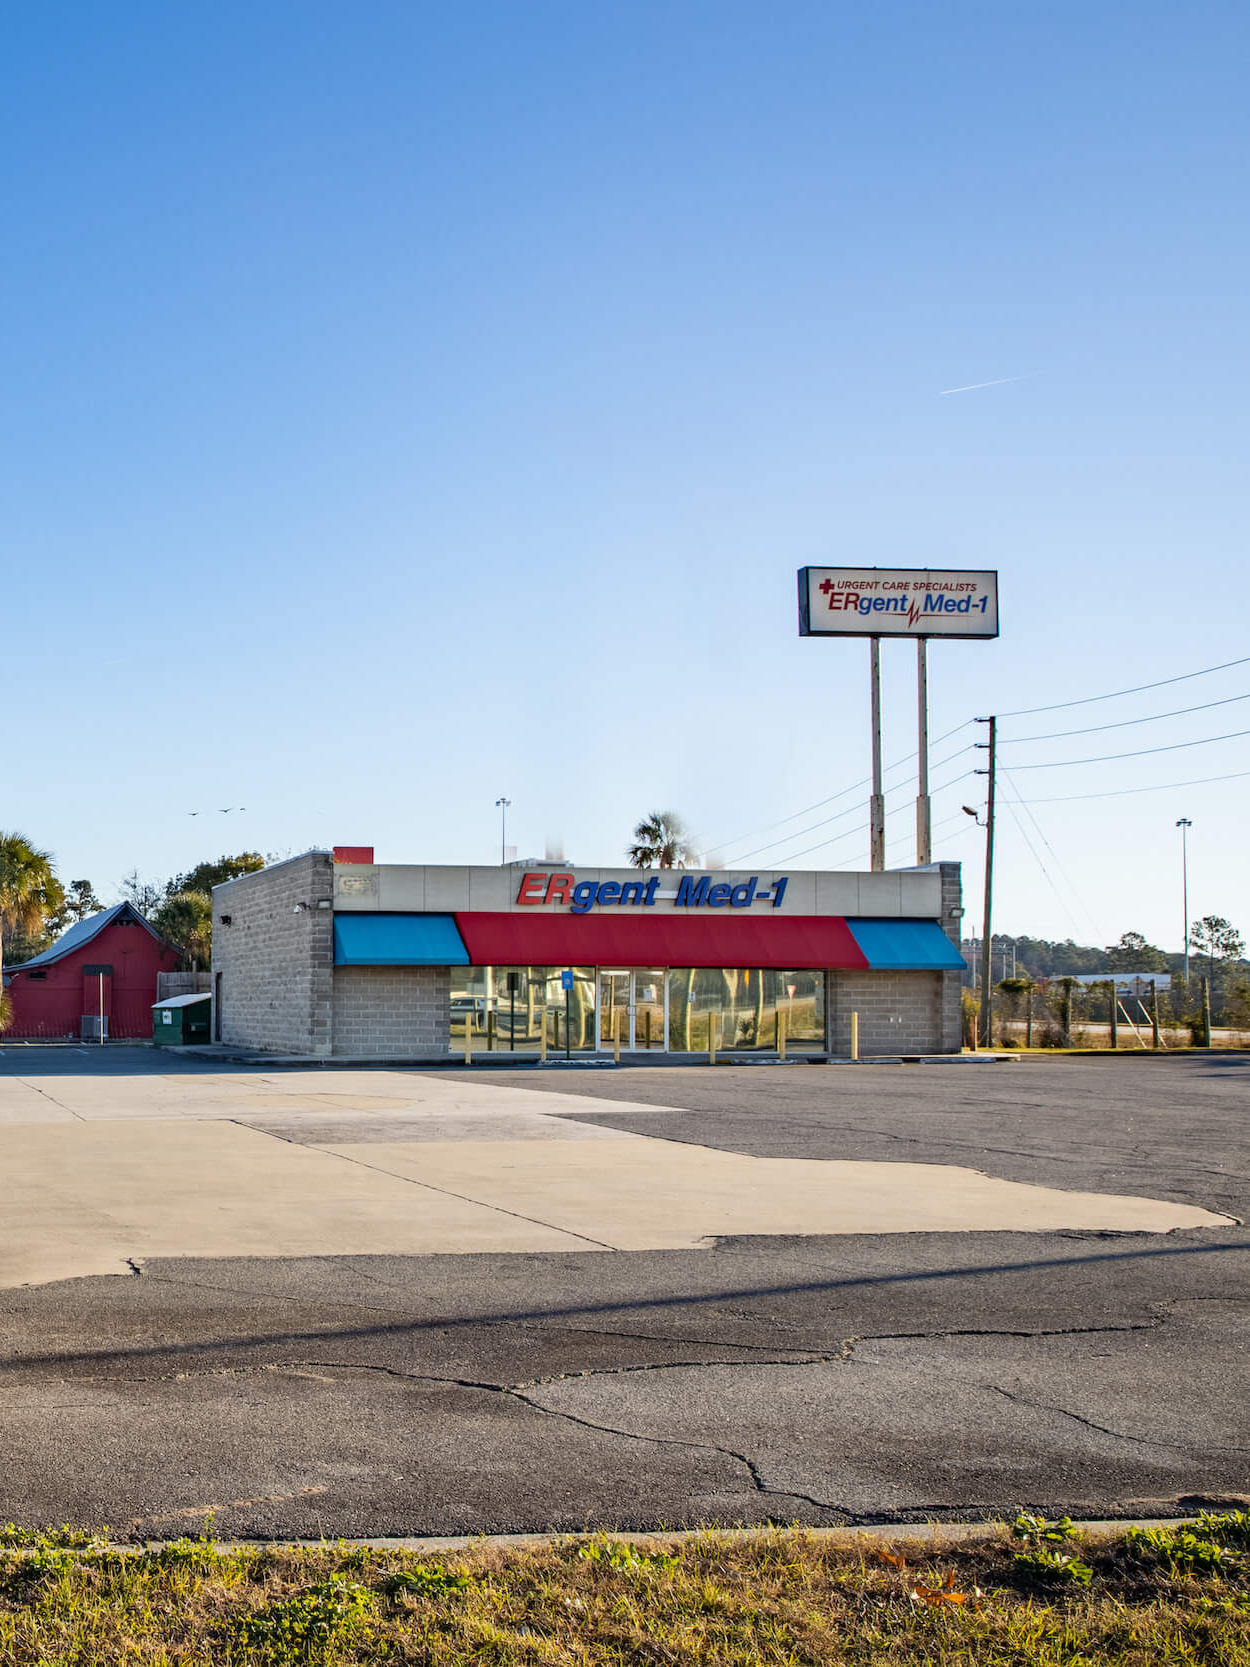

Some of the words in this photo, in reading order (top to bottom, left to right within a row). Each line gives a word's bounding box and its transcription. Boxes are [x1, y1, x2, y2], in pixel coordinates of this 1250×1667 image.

[837, 581, 880, 590] URGENT
[882, 581, 910, 591] CARE
[912, 582, 977, 592] SPECIALISTS
[828, 592, 908, 615] ERgent
[924, 594, 988, 613] Med-1
[517, 872, 660, 914] ERgent
[675, 875, 789, 908] Med-1
